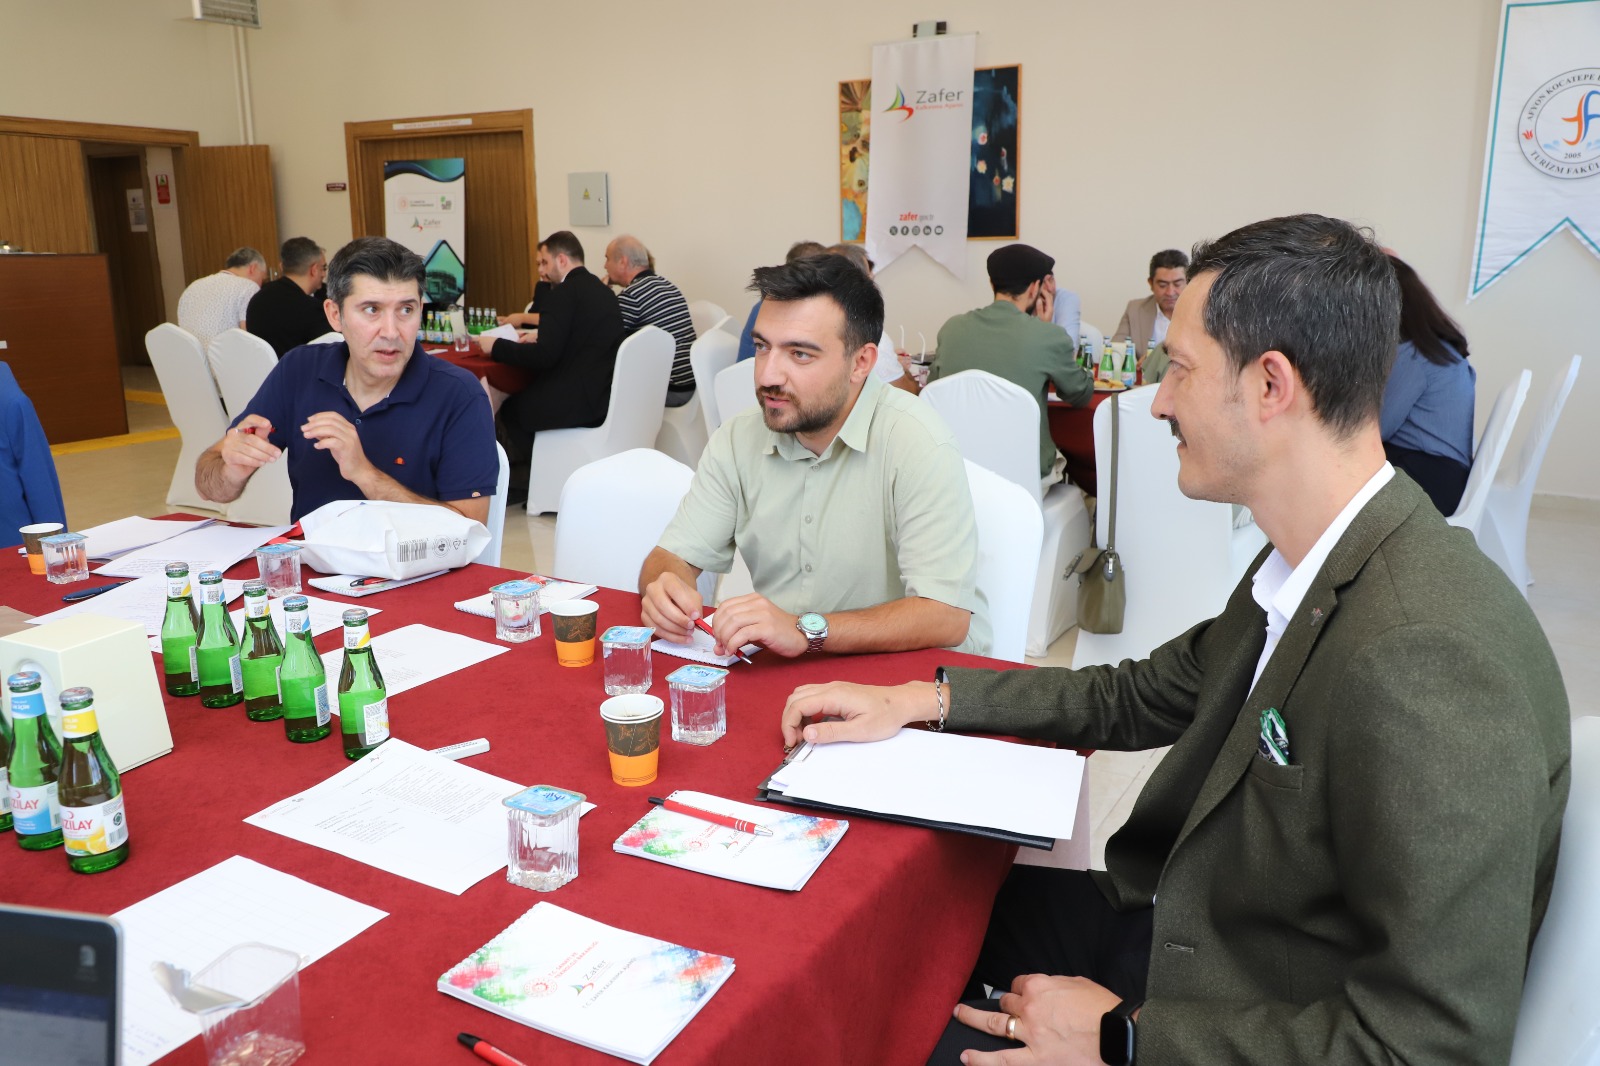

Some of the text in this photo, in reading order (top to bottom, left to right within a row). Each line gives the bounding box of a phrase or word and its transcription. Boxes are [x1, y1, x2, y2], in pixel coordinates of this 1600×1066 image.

[916, 87, 964, 104] Zafer
[1527, 74, 1595, 121] AFYON KOCATEPE
[1530, 150, 1564, 174] TURİZM
[582, 959, 607, 980] Zafer
